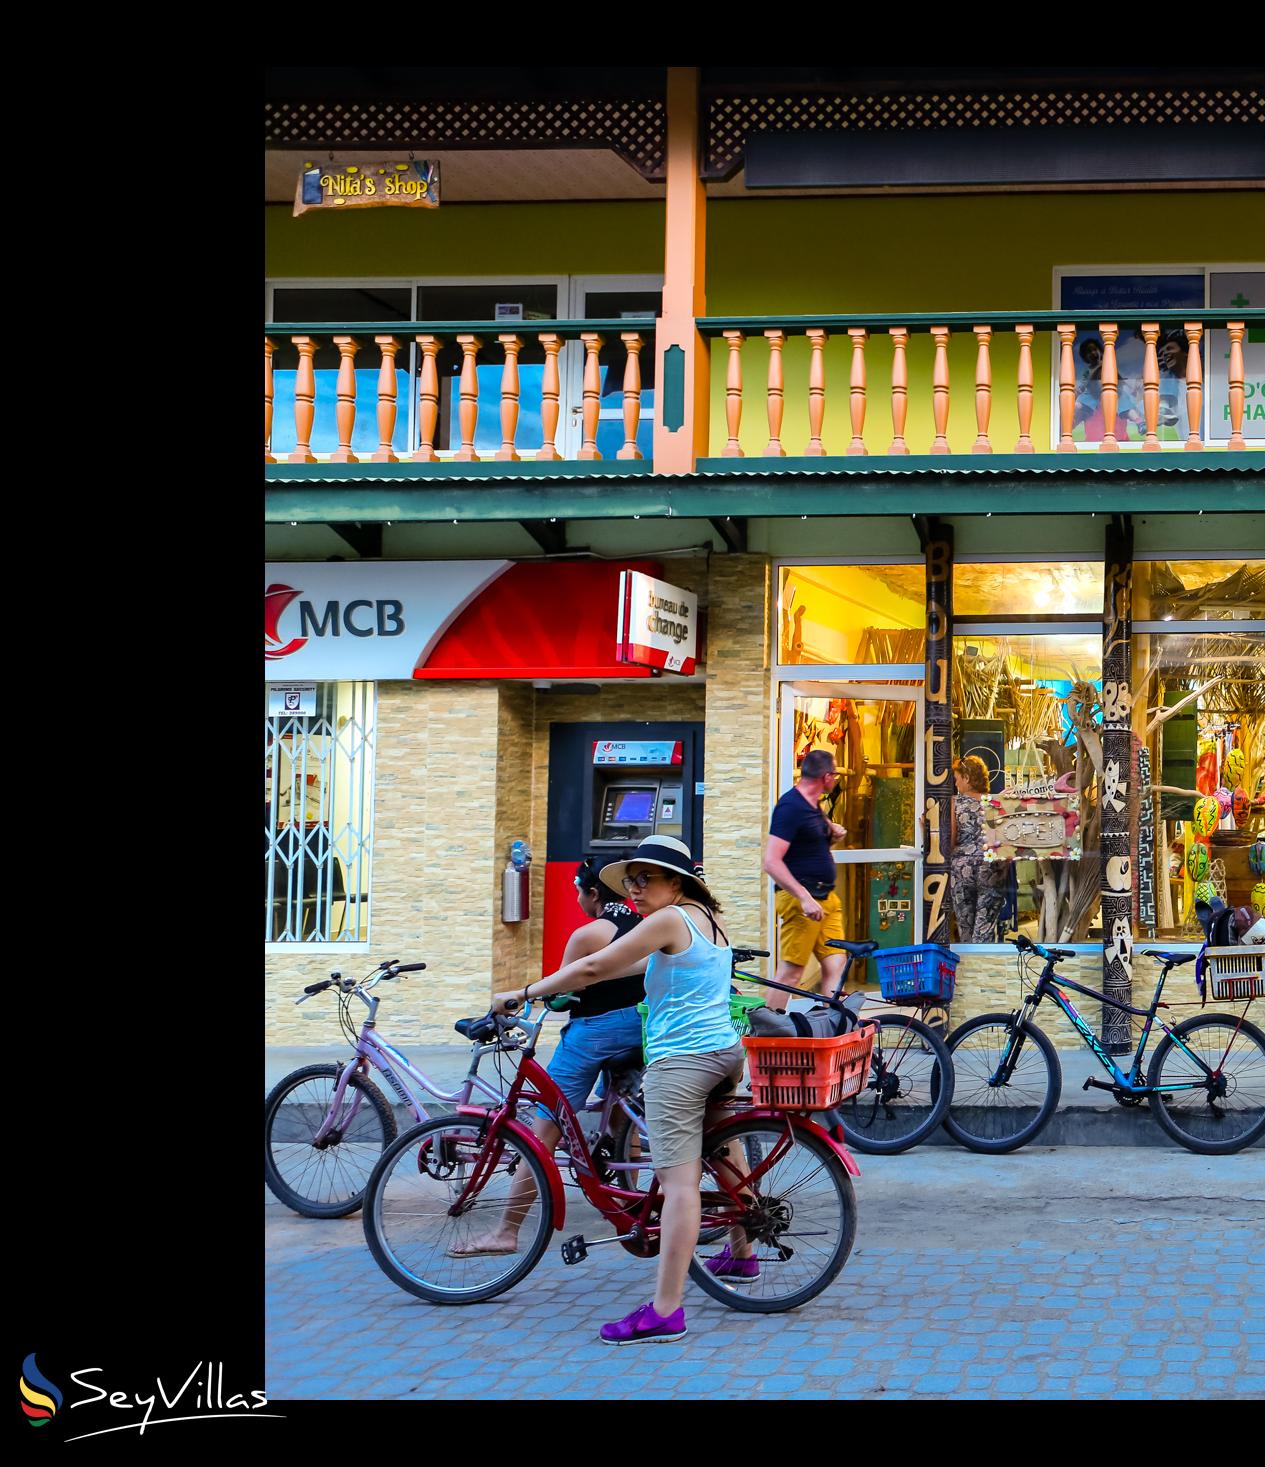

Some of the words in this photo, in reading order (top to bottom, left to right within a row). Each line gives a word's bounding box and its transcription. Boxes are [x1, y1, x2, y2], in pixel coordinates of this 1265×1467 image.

[320, 174, 377, 196] Nita's
[649, 590, 678, 614] bureau
[679, 602, 689, 618] de
[300, 599, 406, 638] MCB
[646, 611, 689, 645] change
[1003, 821, 1064, 841] OPEN
